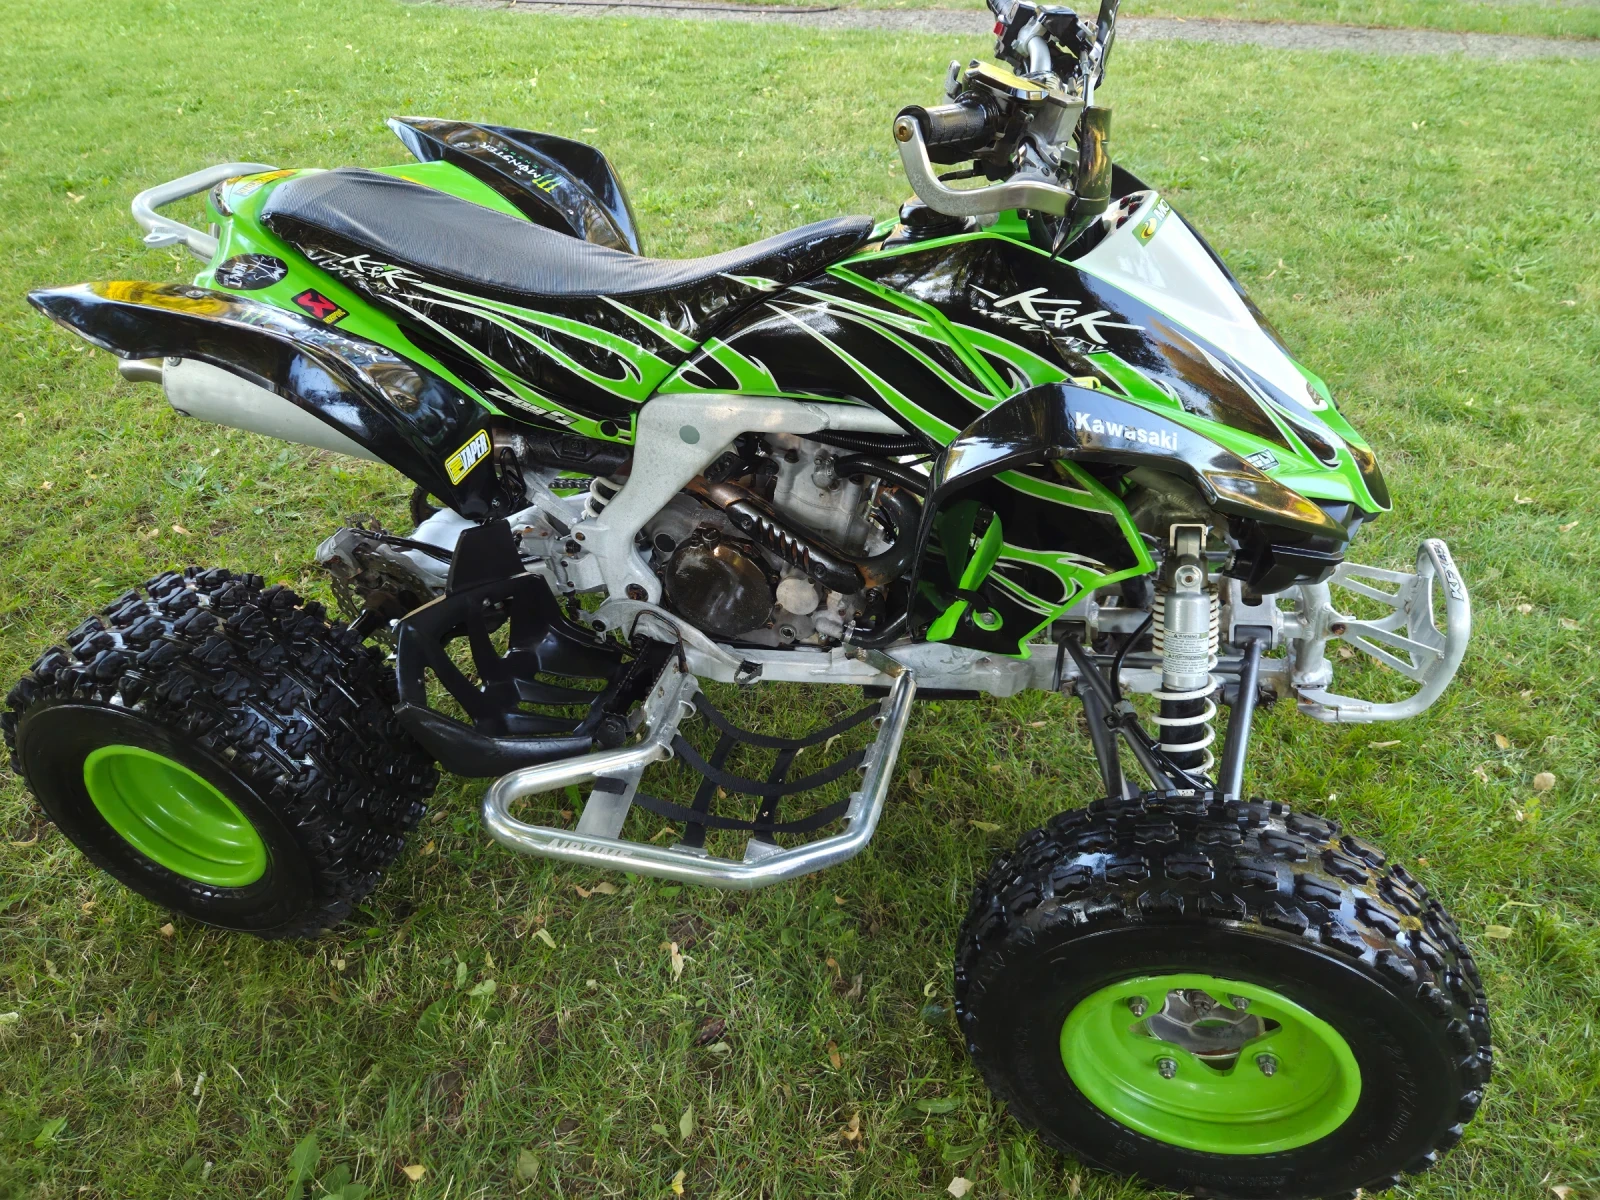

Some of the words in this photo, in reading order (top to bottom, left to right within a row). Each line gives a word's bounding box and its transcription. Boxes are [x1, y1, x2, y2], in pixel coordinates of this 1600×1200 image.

[479, 141, 541, 179] MONSTER
[1075, 412, 1178, 450] Kawasaki
[460, 433, 489, 471] TAPER
